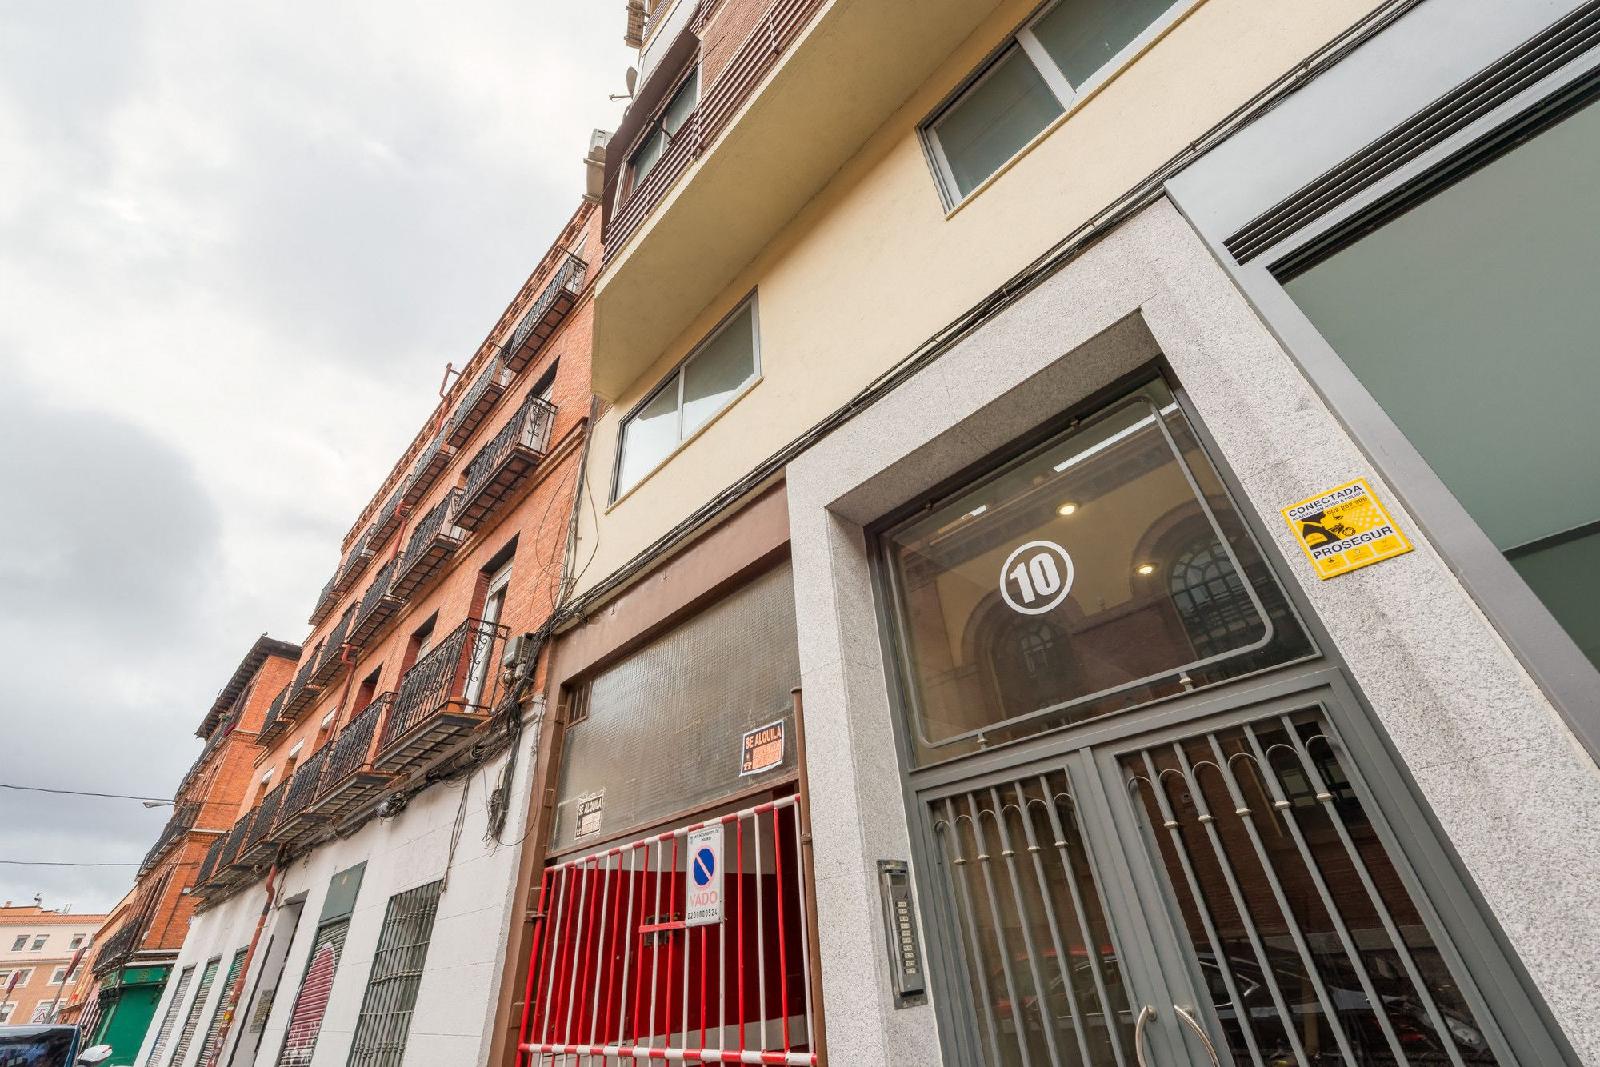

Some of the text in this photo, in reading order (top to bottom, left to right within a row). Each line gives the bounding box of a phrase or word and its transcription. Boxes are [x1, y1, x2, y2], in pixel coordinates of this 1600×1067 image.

[1289, 485, 1363, 517] CONECTADA
[1313, 525, 1394, 560] PROSEGUR
[1009, 552, 1061, 604] 10
[745, 725, 782, 750] SE ALQUILA
[689, 891, 718, 908] VADO
